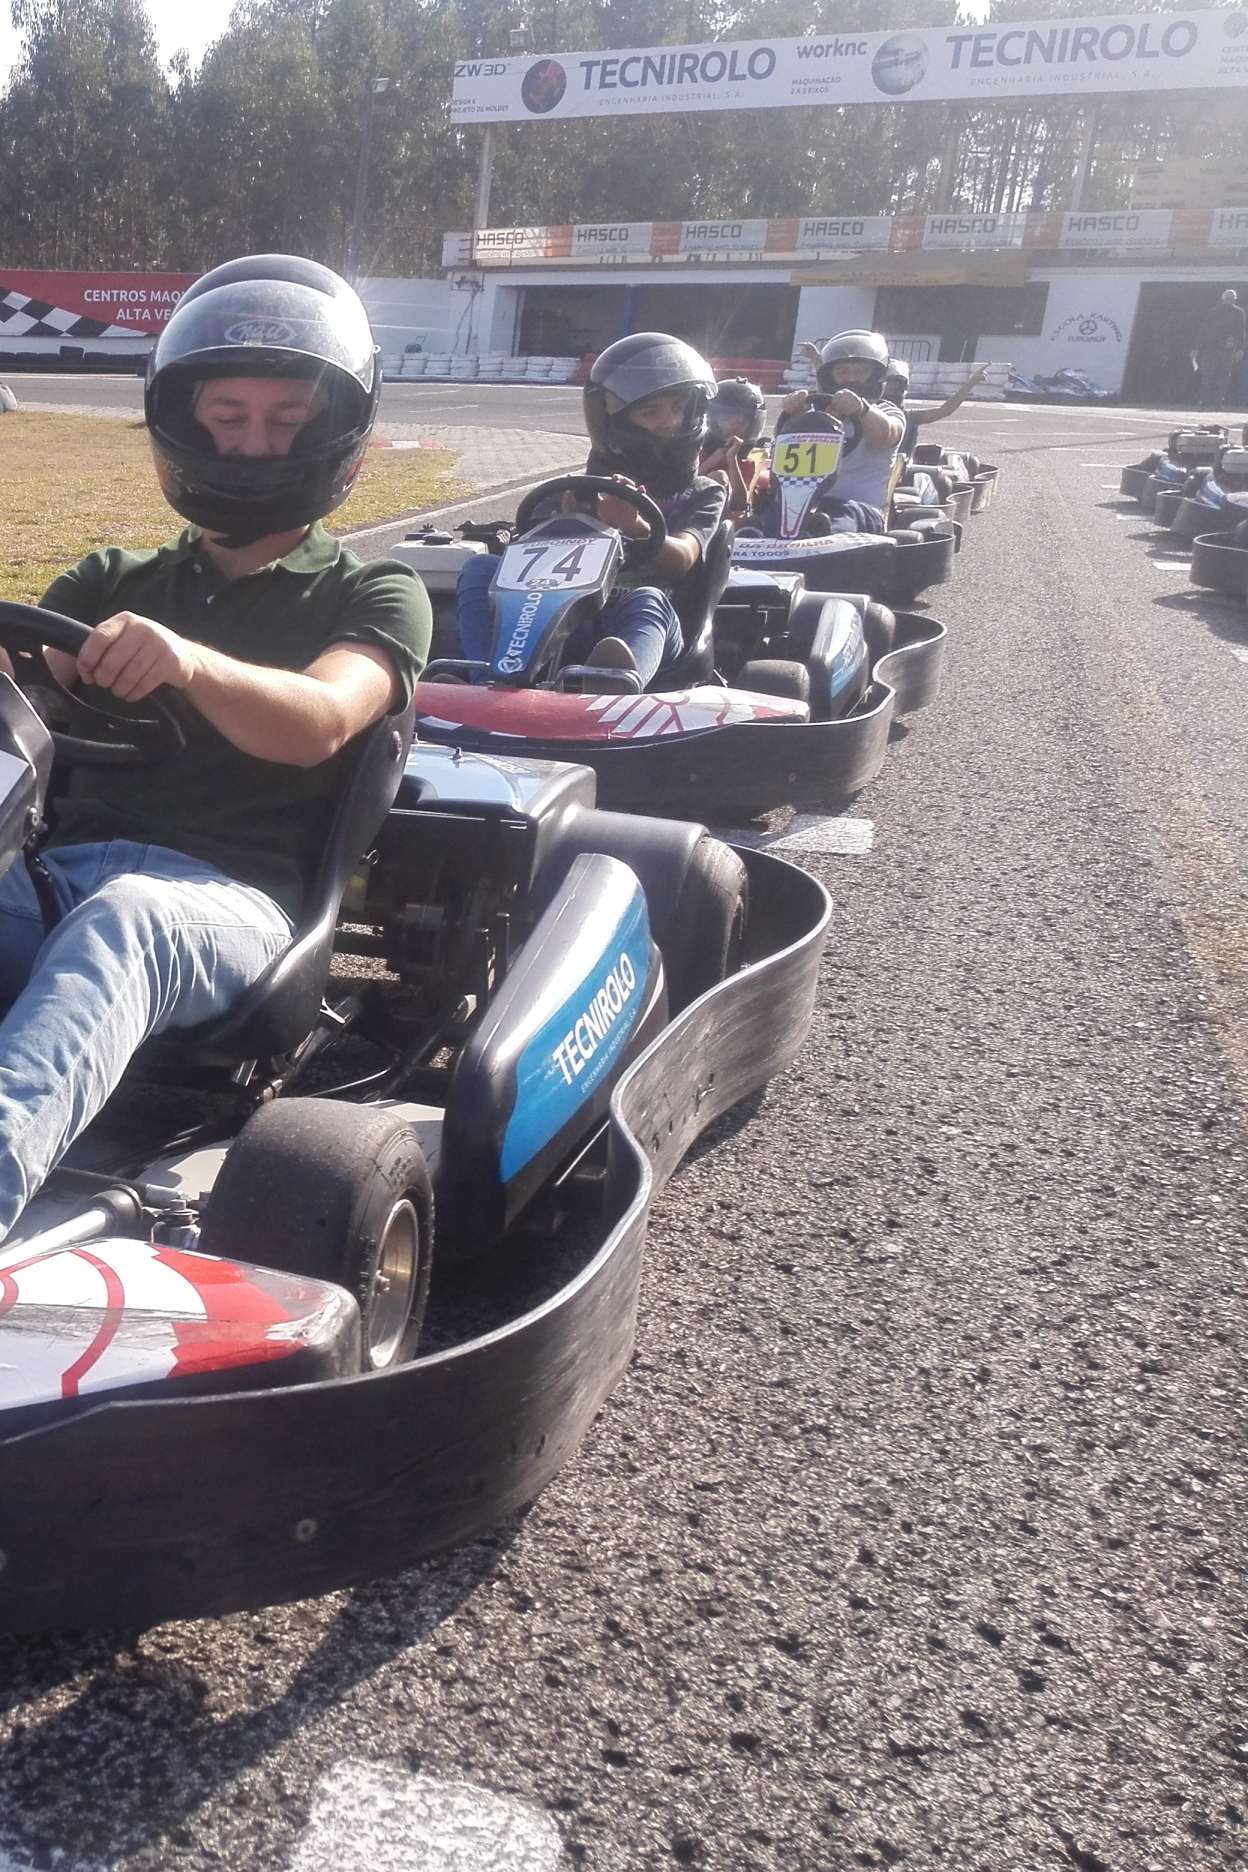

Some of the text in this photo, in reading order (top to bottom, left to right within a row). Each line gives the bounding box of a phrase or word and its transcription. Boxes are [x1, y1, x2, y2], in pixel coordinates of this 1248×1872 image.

[796, 38, 869, 59] worknc
[946, 20, 1198, 70] TECNIROLO
[579, 47, 777, 90] TECNIROLO
[685, 224, 742, 239] HASCO
[803, 221, 865, 237] HASCO
[929, 217, 997, 234] HASCO
[1068, 215, 1140, 232] HASCO
[476, 231, 525, 246] HASCO
[577, 227, 629, 242] HASCO
[83, 289, 147, 303] CENTROS
[116, 308, 176, 321] ALTA VE
[783, 443, 817, 474] 51
[517, 545, 587, 583] 74
[510, 591, 543, 657] TECNIROLO
[551, 952, 636, 1085] TECNIROLO
